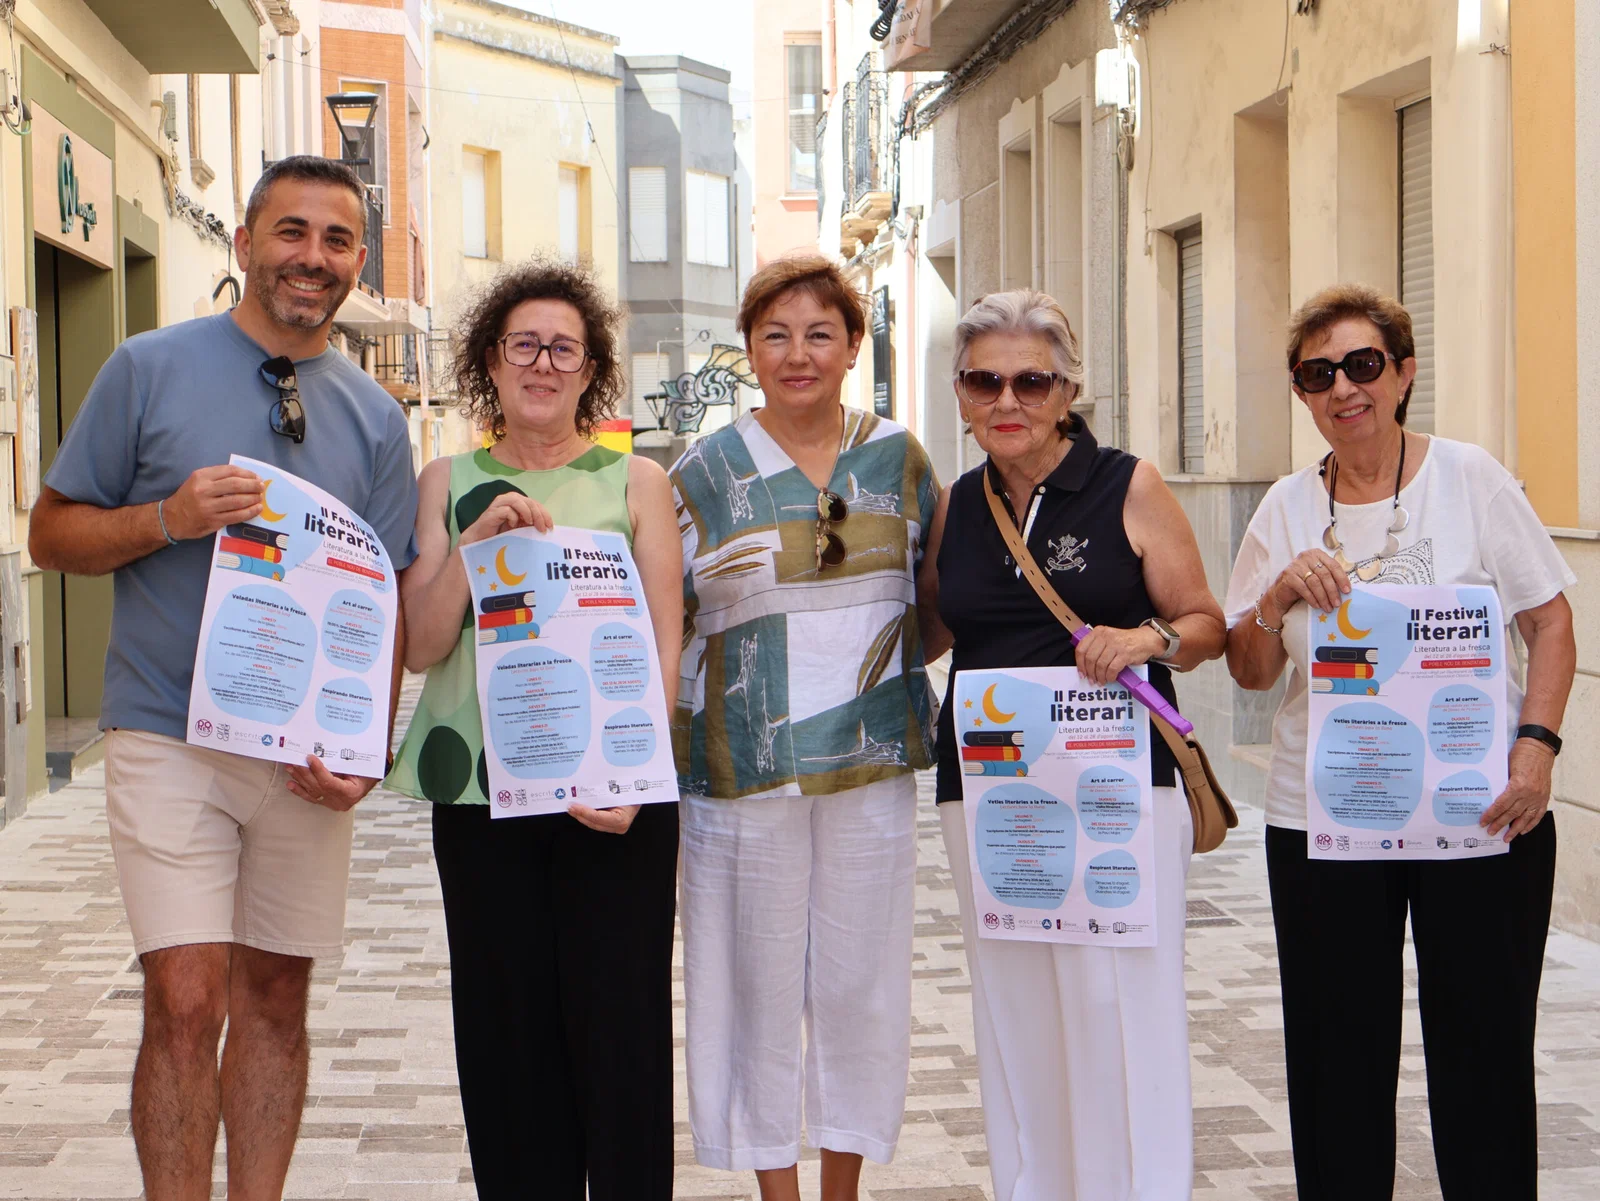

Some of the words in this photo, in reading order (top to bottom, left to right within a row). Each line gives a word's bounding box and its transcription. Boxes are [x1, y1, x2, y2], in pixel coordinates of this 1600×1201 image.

[321, 506, 328, 518] II
[332, 511, 376, 542] Festival
[304, 512, 380, 556] literario
[322, 541, 354, 556] Literatura
[564, 548, 572, 560] II
[574, 549, 622, 562] Festival
[546, 562, 628, 580] literario
[232, 593, 254, 602] Veladas
[255, 598, 279, 608] literarias
[290, 607, 307, 616] fresca
[1411, 609, 1420, 620] II
[1426, 606, 1488, 620] Festival
[1407, 620, 1489, 640] literari
[349, 693, 372, 702] literatura
[1054, 690, 1063, 702] II
[1068, 688, 1132, 702] Festival
[1050, 702, 1134, 722] literari
